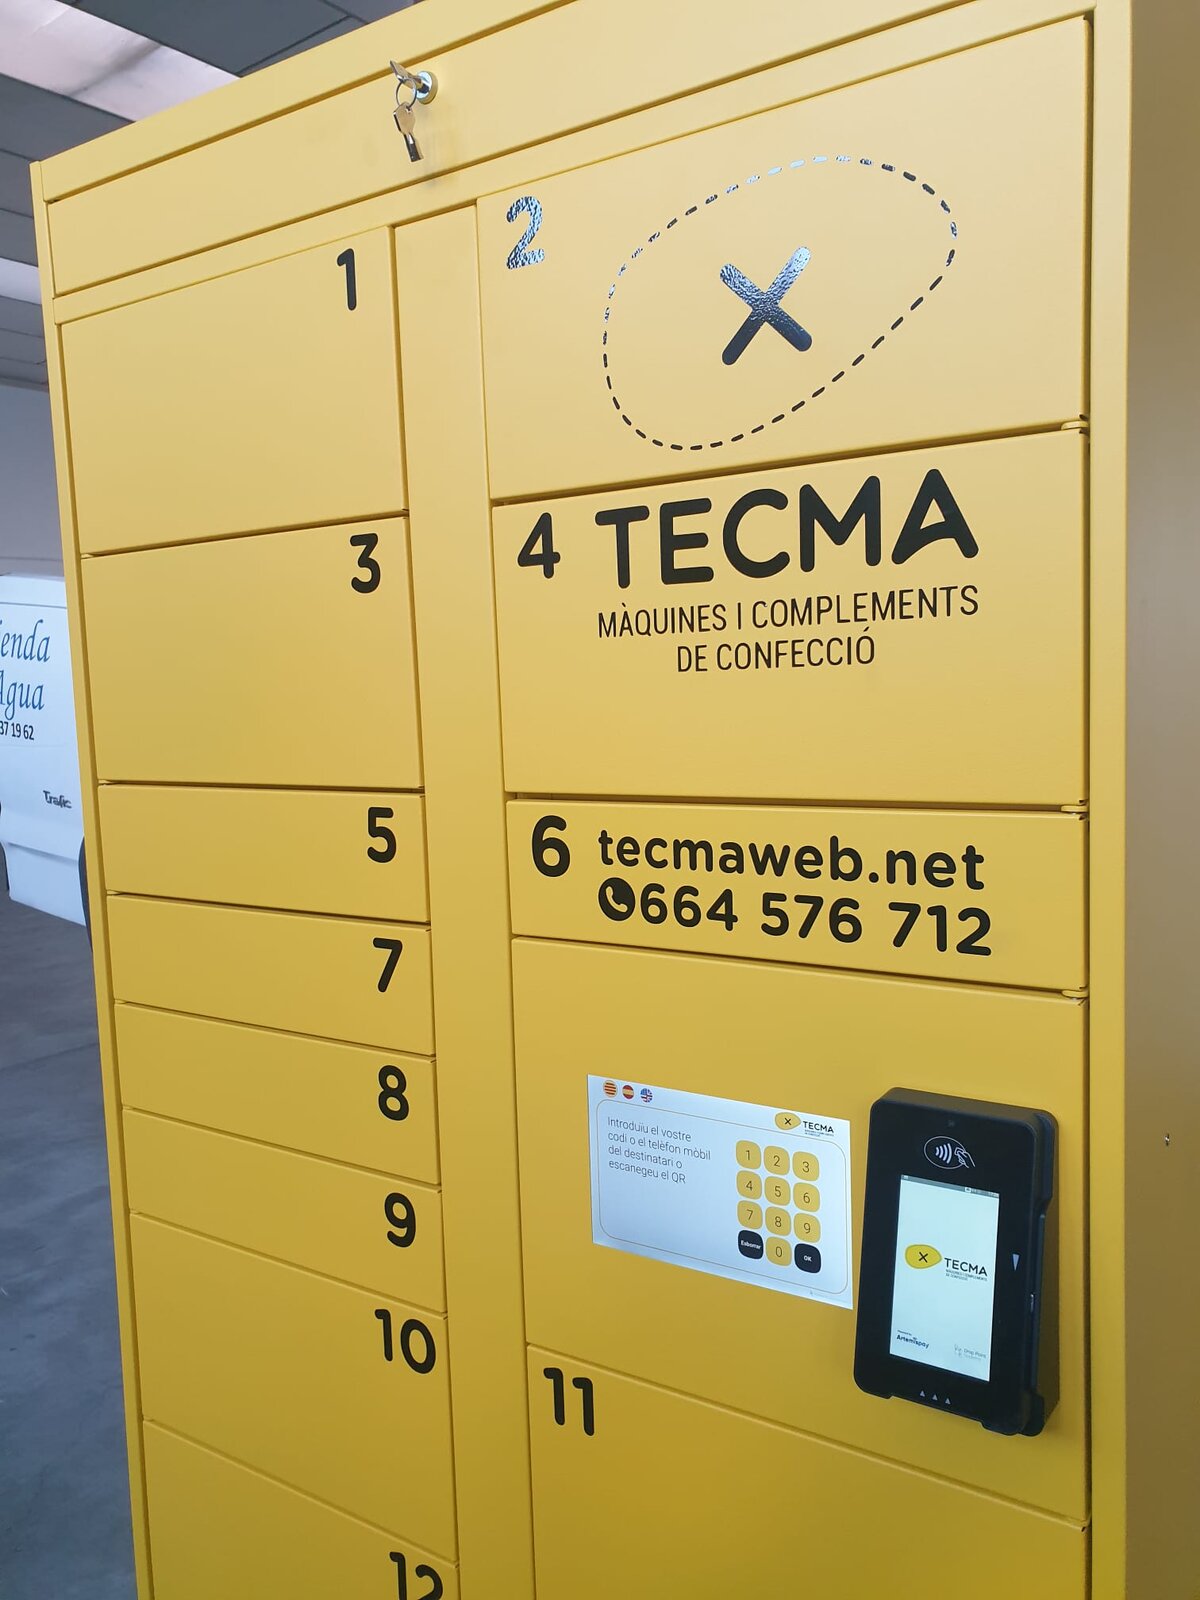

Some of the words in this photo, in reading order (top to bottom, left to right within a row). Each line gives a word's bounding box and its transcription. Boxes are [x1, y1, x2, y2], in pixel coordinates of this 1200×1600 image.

[506, 195, 545, 270] 2
[336, 248, 357, 311] 1
[516, 511, 561, 579] 4
[594, 468, 979, 589] TECMA
[349, 531, 381, 594] 3
[597, 603, 727, 638] MÀQUINES
[737, 602, 742, 630] I
[752, 584, 979, 629] COMPLEMENTS
[0, 618, 50, 662] enda
[677, 645, 708, 673] DE
[716, 626, 875, 671] CONFECCIÓ
[23, 724, 34, 740] 62
[42, 789, 73, 809] Trafic
[367, 806, 397, 864] 5
[531, 814, 571, 878] 6
[598, 829, 985, 891] tecmaweb.net
[640, 882, 739, 932] 664
[760, 892, 863, 944] 576
[888, 901, 992, 957] 712
[372, 937, 404, 993] 7
[378, 1064, 410, 1122] 8
[607, 1132, 627, 1143] codi
[629, 1136, 636, 1145] o
[637, 1137, 646, 1147] el
[683, 1147, 711, 1160] mòbil
[650, 1125, 659, 1136] el
[661, 1129, 692, 1142] vostre
[802, 1121, 834, 1133] TECMA
[608, 1144, 622, 1156] del
[623, 1148, 674, 1167] destinatari
[675, 1160, 683, 1169] o
[608, 1160, 659, 1179] escanegeu
[660, 1170, 669, 1181] el
[671, 1171, 686, 1184] QR
[745, 1149, 751, 1161] 1
[773, 1154, 781, 1168] 2
[802, 1161, 810, 1173] 3
[745, 1180, 753, 1192] 4
[774, 1185, 782, 1198] 5
[803, 1192, 811, 1204] 6
[384, 1192, 417, 1248] 9
[746, 1209, 754, 1221] 7
[774, 1216, 782, 1228] 8
[803, 1222, 811, 1235] 9
[775, 1246, 783, 1258] 0
[943, 1257, 988, 1277] TECMA
[374, 1308, 437, 1375] 10
[543, 1367, 595, 1437] 11
[388, 1551, 444, 1600] 12
